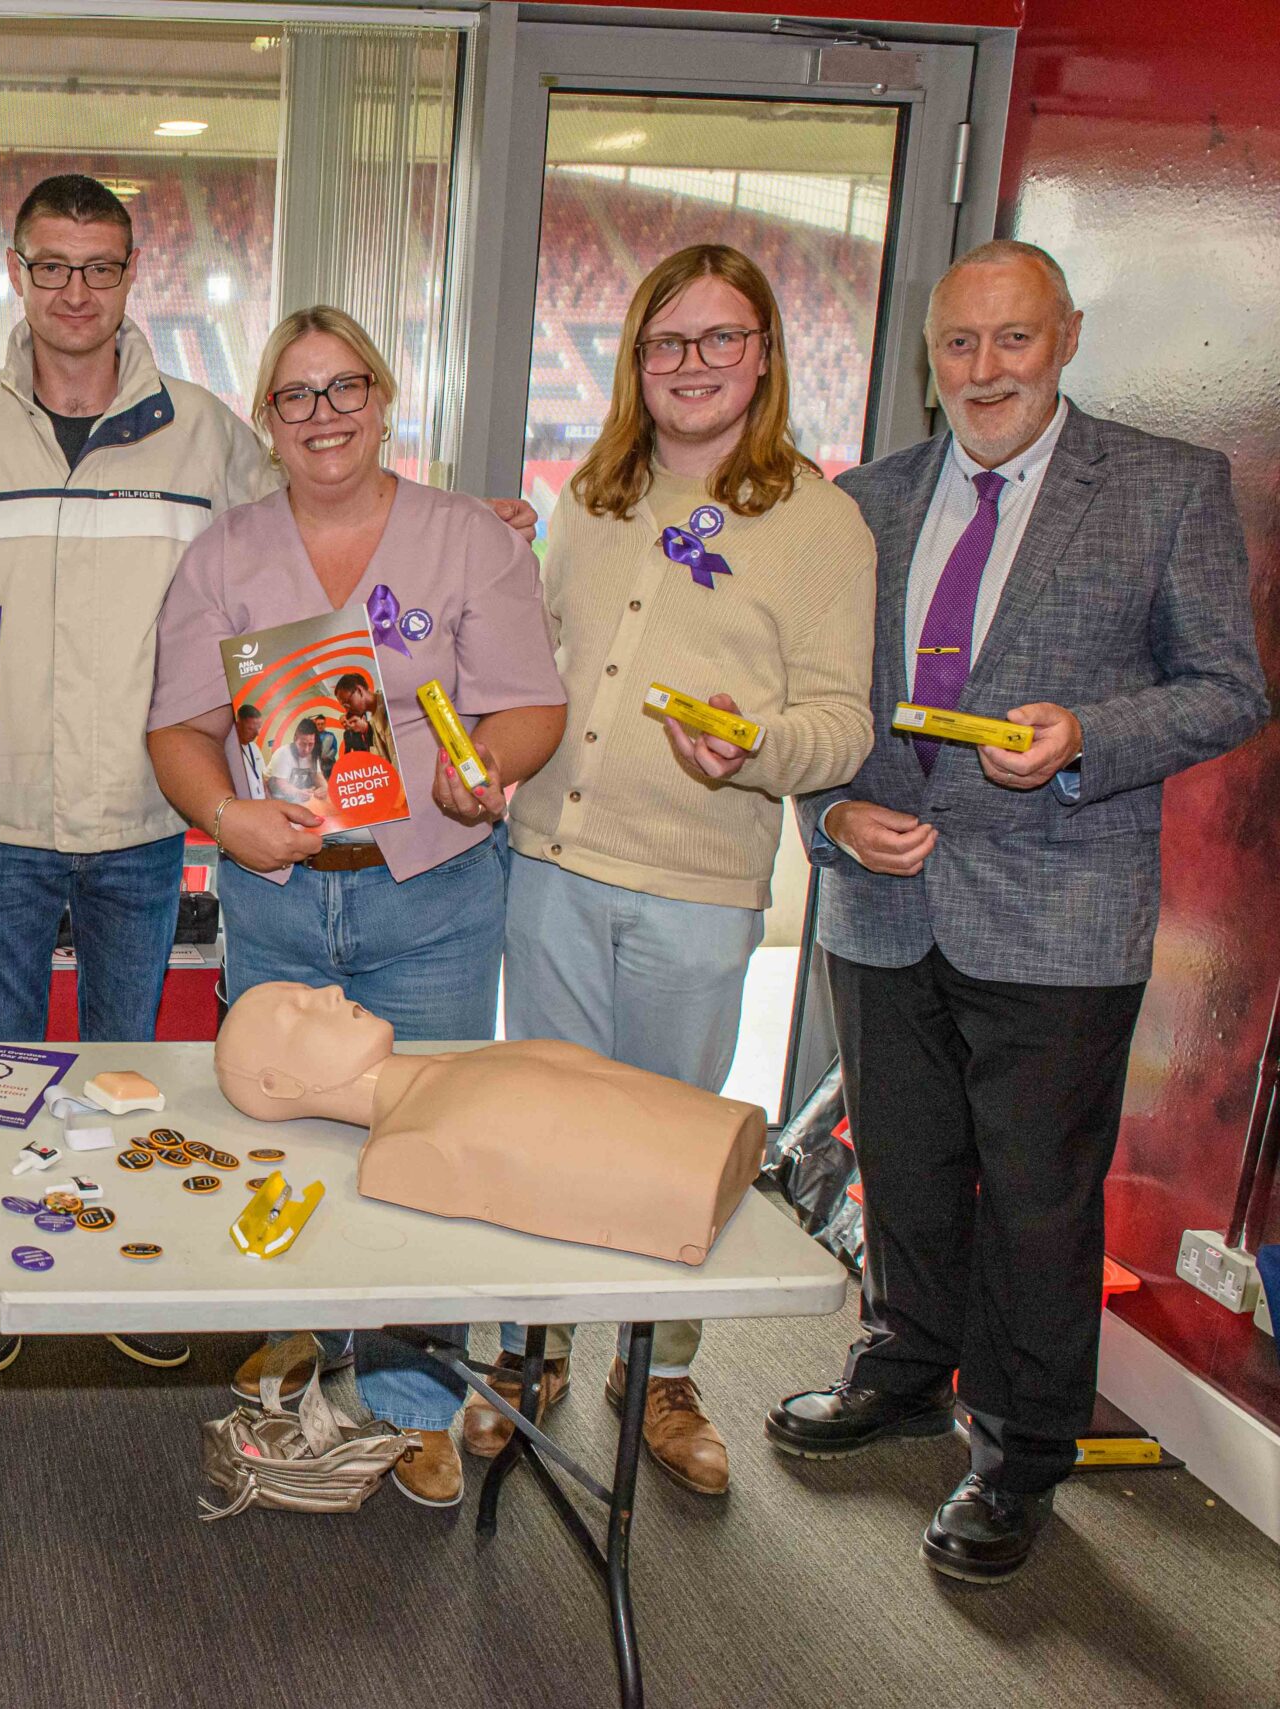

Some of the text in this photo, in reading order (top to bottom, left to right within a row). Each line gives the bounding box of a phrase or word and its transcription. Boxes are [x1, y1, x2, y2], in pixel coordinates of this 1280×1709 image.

[118, 490, 161, 499] HILFIGER
[335, 763, 388, 784] ANNUAL
[337, 776, 390, 797] REPORT
[341, 793, 375, 809] 2025
[8, 1050, 47, 1058] Overdose
